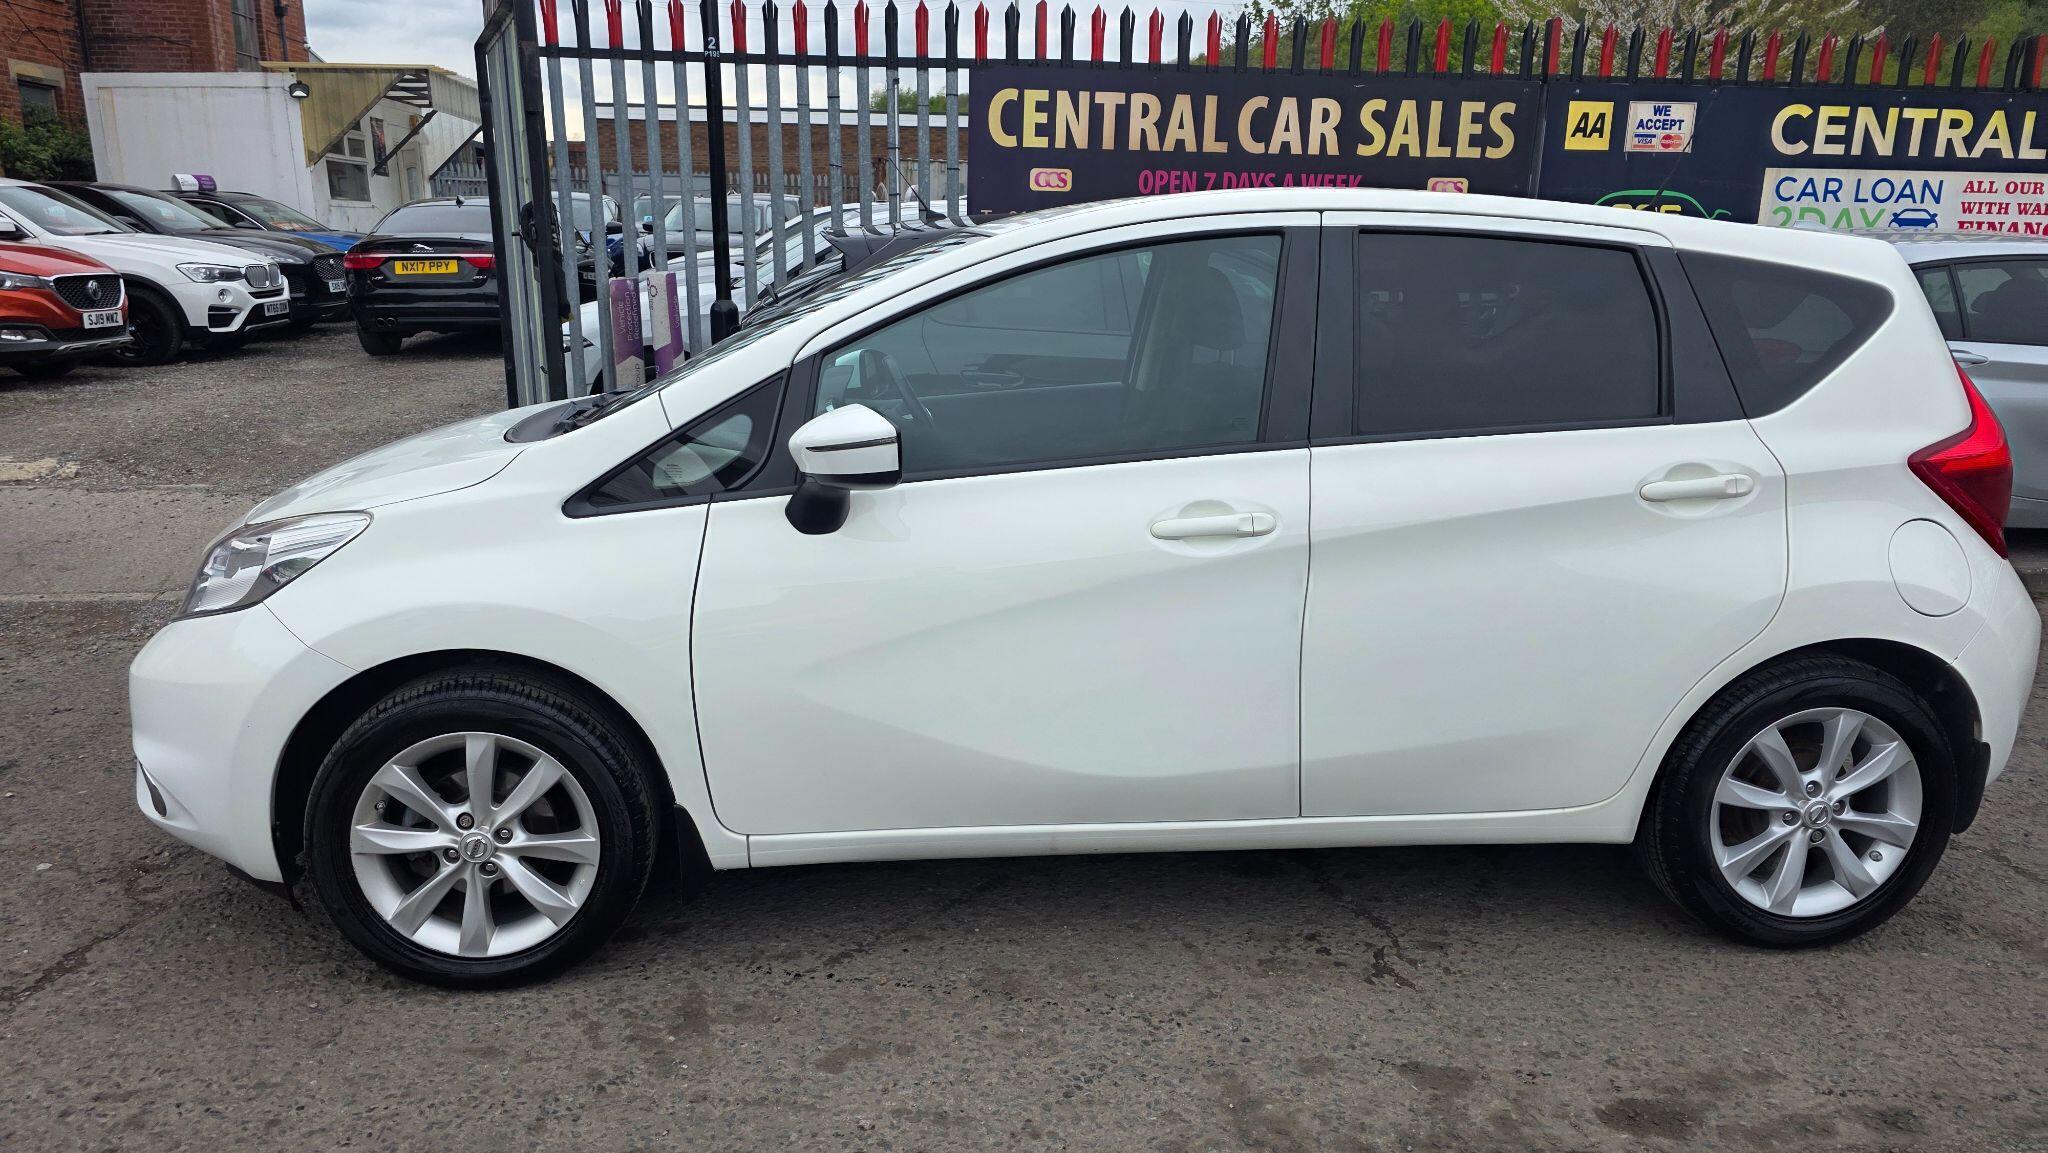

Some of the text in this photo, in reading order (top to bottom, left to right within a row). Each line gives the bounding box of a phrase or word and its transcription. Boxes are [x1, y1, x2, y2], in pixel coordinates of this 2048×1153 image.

[707, 36, 716, 49] 2
[1653, 104, 1672, 117] WE
[988, 87, 1517, 160] CENTRAL CAR SALES
[1570, 111, 1607, 139] AA
[1635, 118, 1685, 131] ACCEPT
[1770, 103, 2047, 160] CENTRAL
[1138, 168, 1197, 195] OPEN
[1203, 172, 1218, 191] 7
[1222, 172, 1276, 190] DAYS
[1775, 176, 1944, 205] CAR LOAN
[1962, 180, 2046, 195] ALL OUR
[1960, 201, 2012, 215] WITH
[401, 260, 451, 272] NX17 PPY
[87, 314, 105, 326] SJ19
[617, 301, 626, 335] Vehicle
[624, 291, 634, 341] Protection
